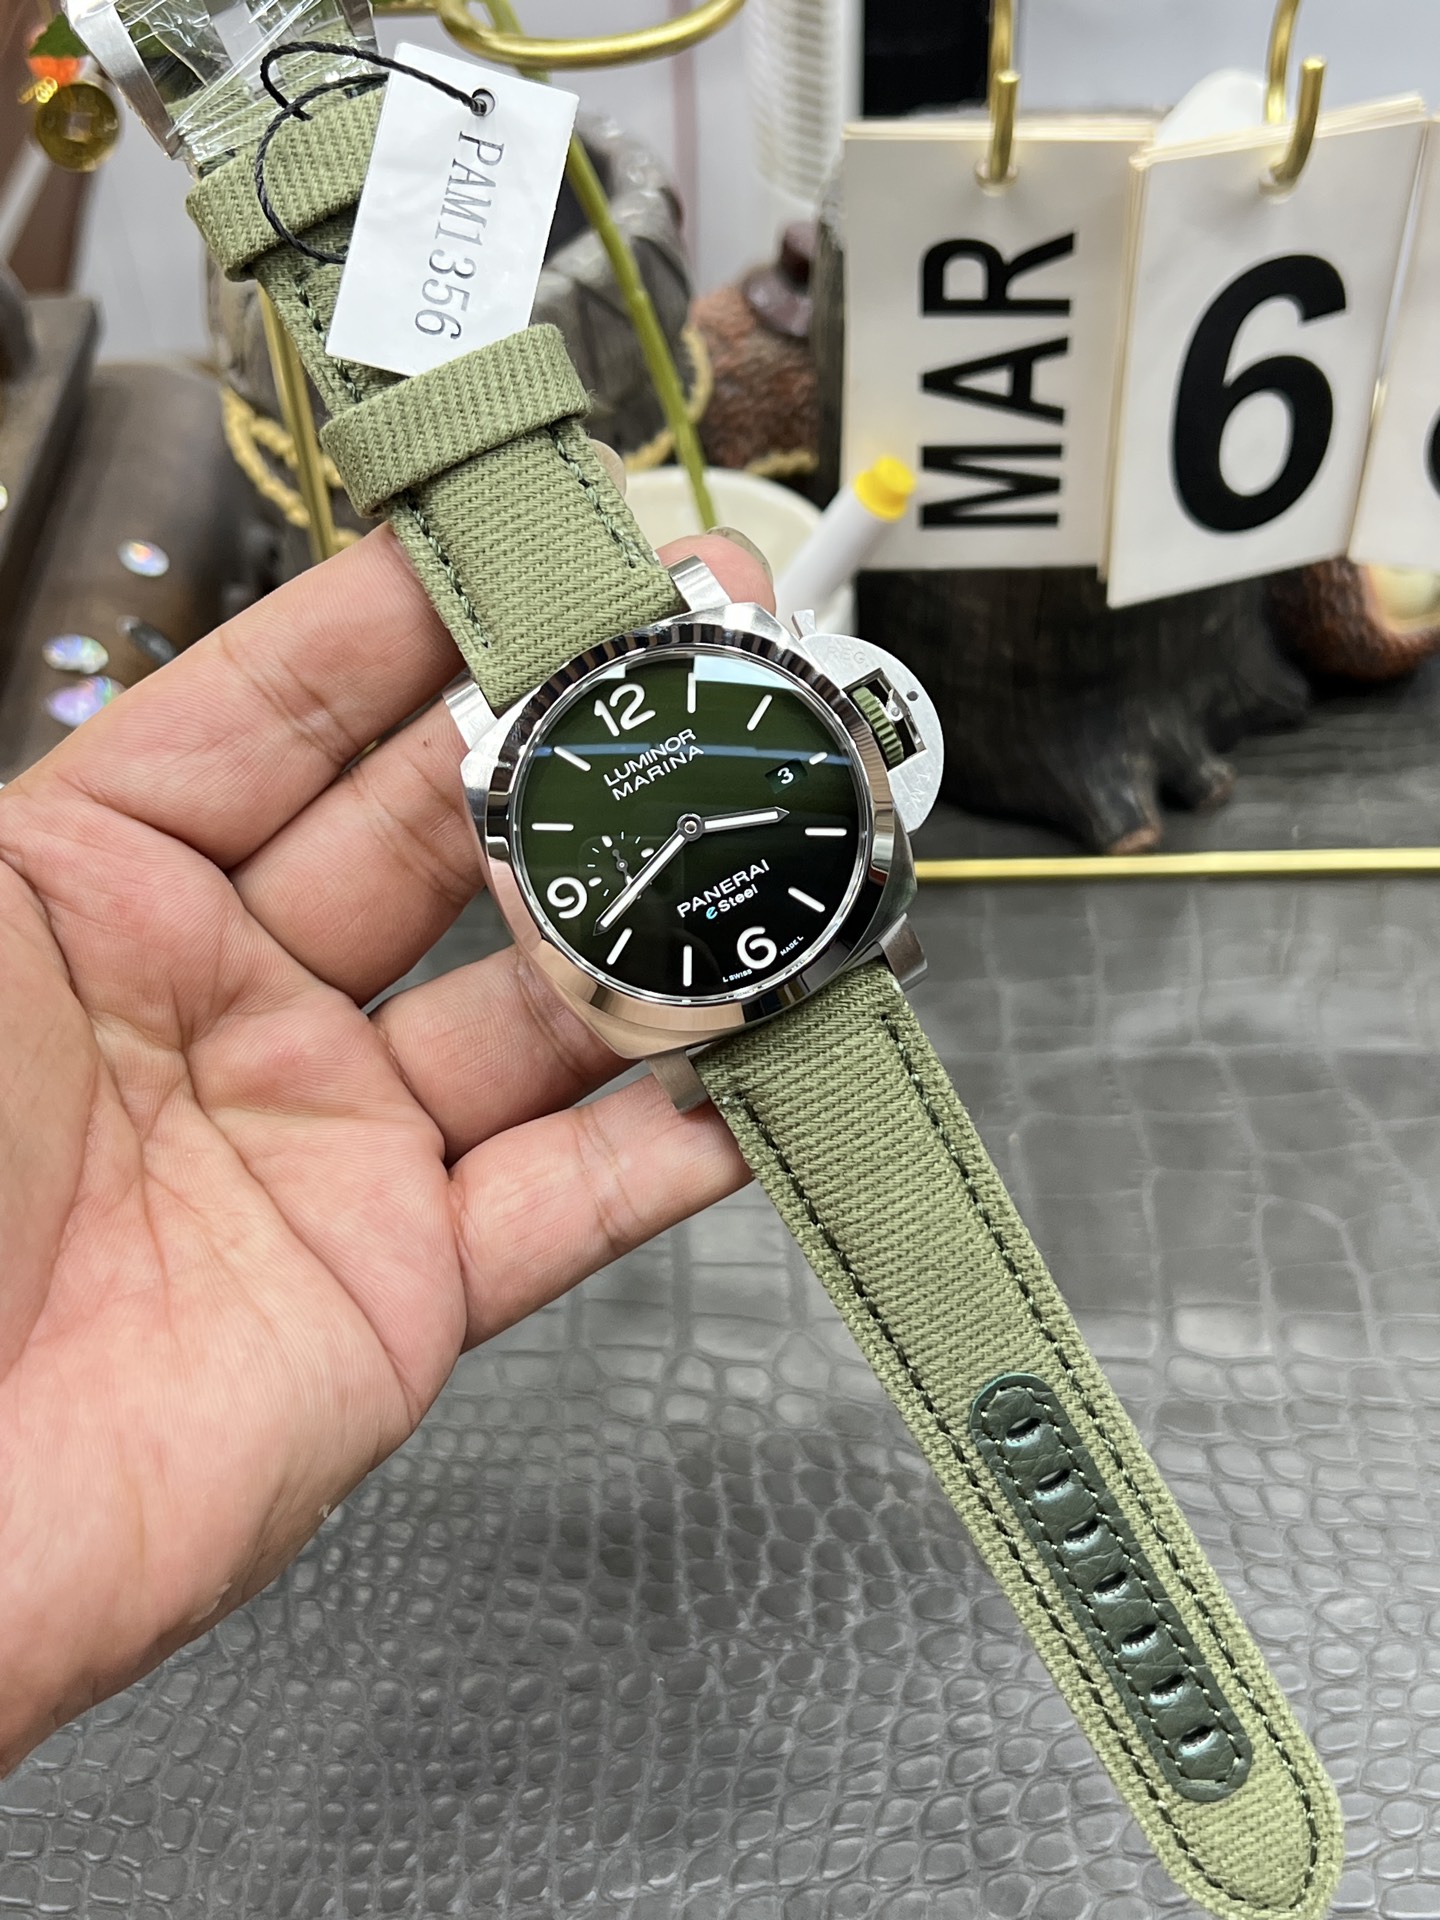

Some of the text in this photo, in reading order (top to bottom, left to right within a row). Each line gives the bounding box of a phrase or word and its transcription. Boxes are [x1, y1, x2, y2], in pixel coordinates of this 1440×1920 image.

[415, 130, 505, 340] PAM1356
[920, 231, 1075, 529] MAR
[1173, 253, 1347, 533] 6
[593, 683, 657, 737] 12
[603, 728, 697, 787] LUMINOR
[611, 745, 704, 801] MARINA
[777, 766, 794, 785] 3
[546, 876, 588, 919] 9
[676, 858, 770, 918] PANERAI
[736, 925, 778, 970] 6
[779, 940, 799, 957] MADE
